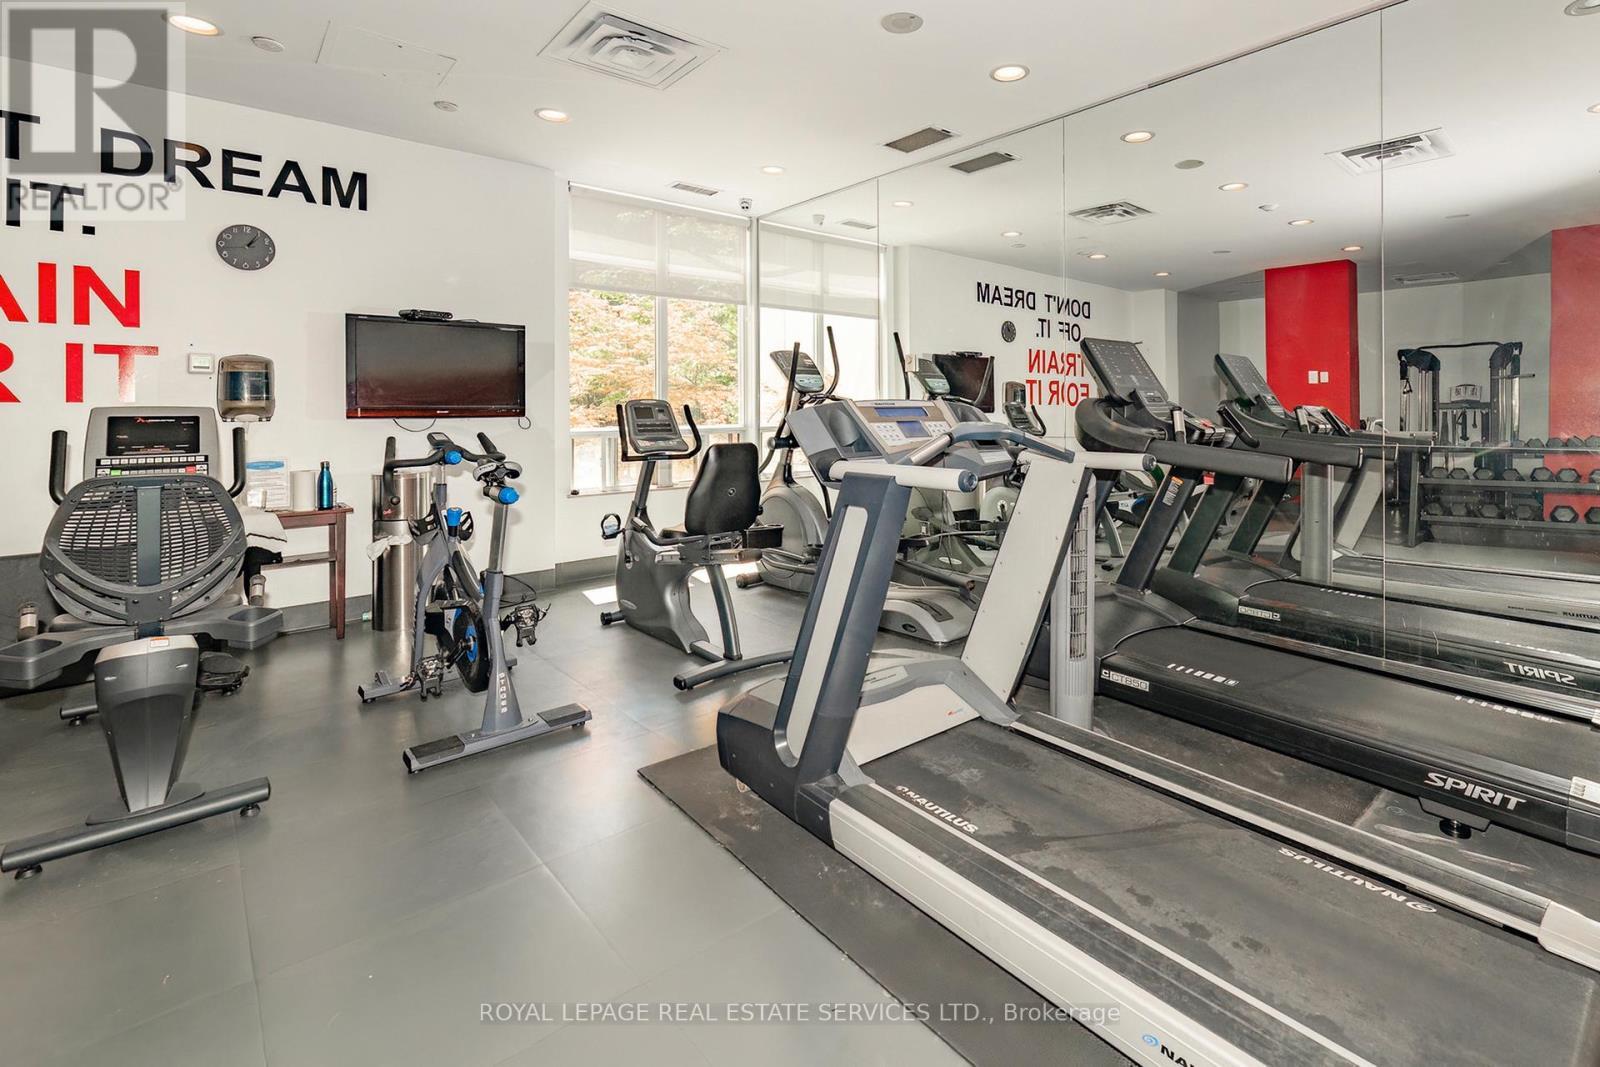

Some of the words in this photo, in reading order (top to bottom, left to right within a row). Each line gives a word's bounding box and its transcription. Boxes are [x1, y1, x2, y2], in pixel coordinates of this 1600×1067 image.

[100, 127, 368, 212] DREAM
[6, 178, 96, 236] IT.
[65, 342, 159, 403] IT
[905, 789, 980, 834] NAUTILUS
[1424, 772, 1527, 811] SPIRIT
[1278, 847, 1408, 903] NAUTILUS
